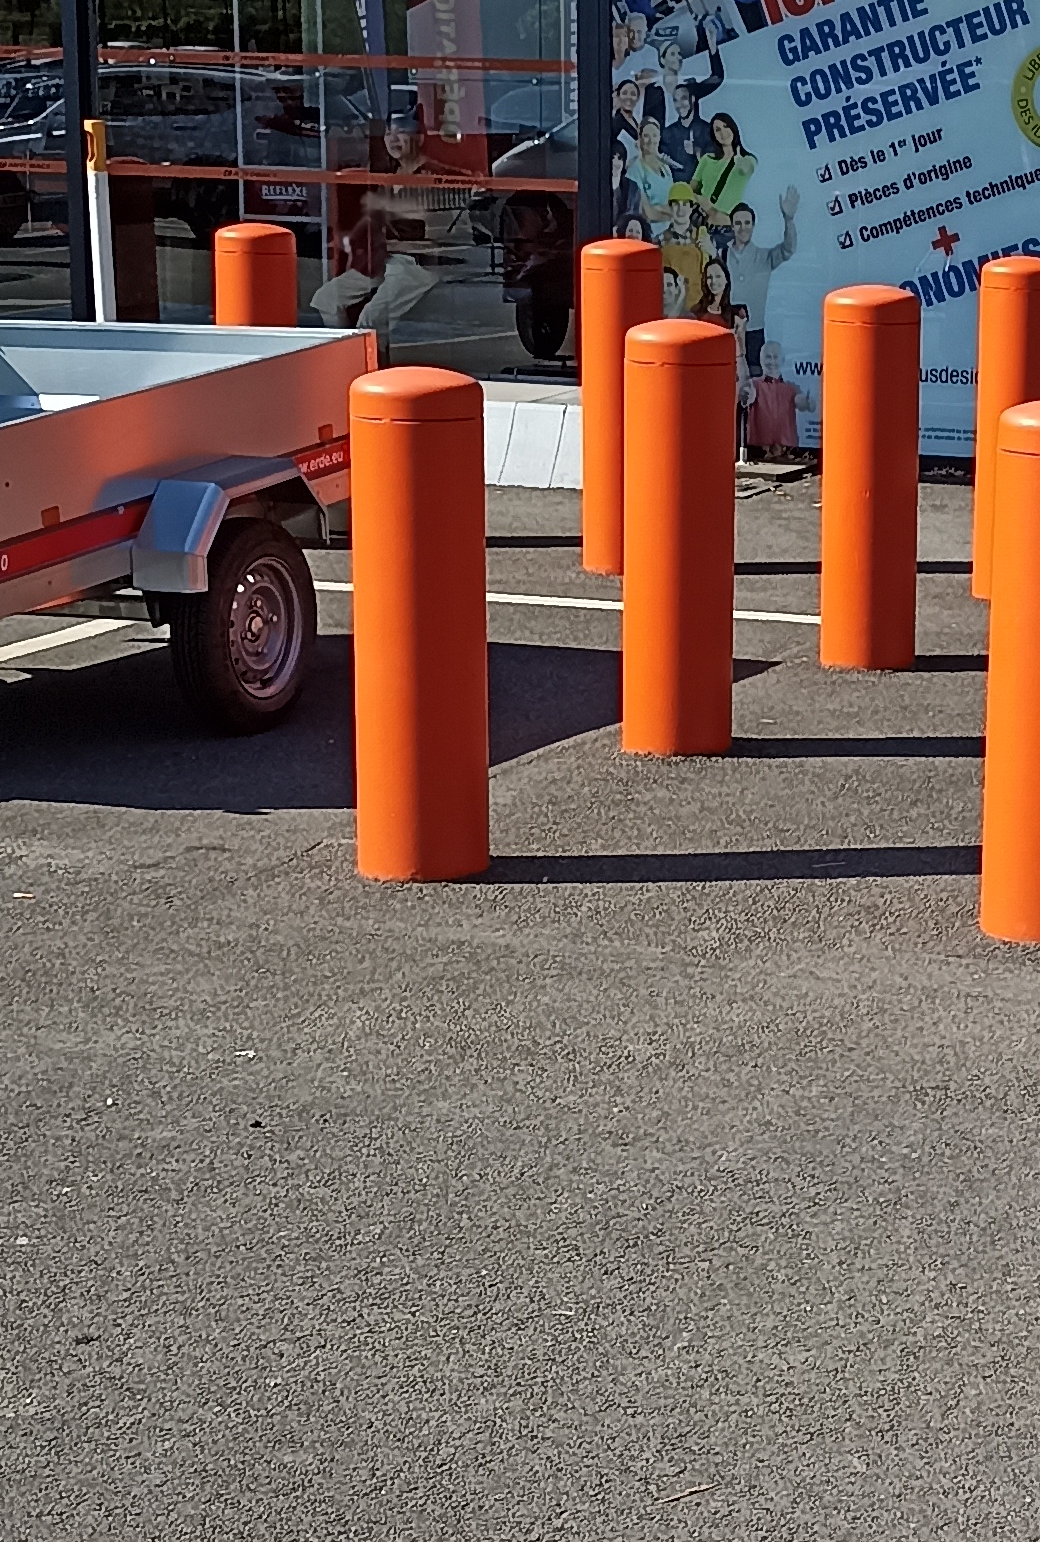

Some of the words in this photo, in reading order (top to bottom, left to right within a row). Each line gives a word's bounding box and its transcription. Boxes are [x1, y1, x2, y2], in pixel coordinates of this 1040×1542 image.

[1017, 99, 1033, 125] DES
[838, 156, 867, 176] Dès
[870, 149, 885, 165] le
[912, 127, 943, 153] jour
[848, 185, 899, 209] Pièces
[903, 156, 973, 190] d'origine
[859, 196, 963, 242] Compétences
